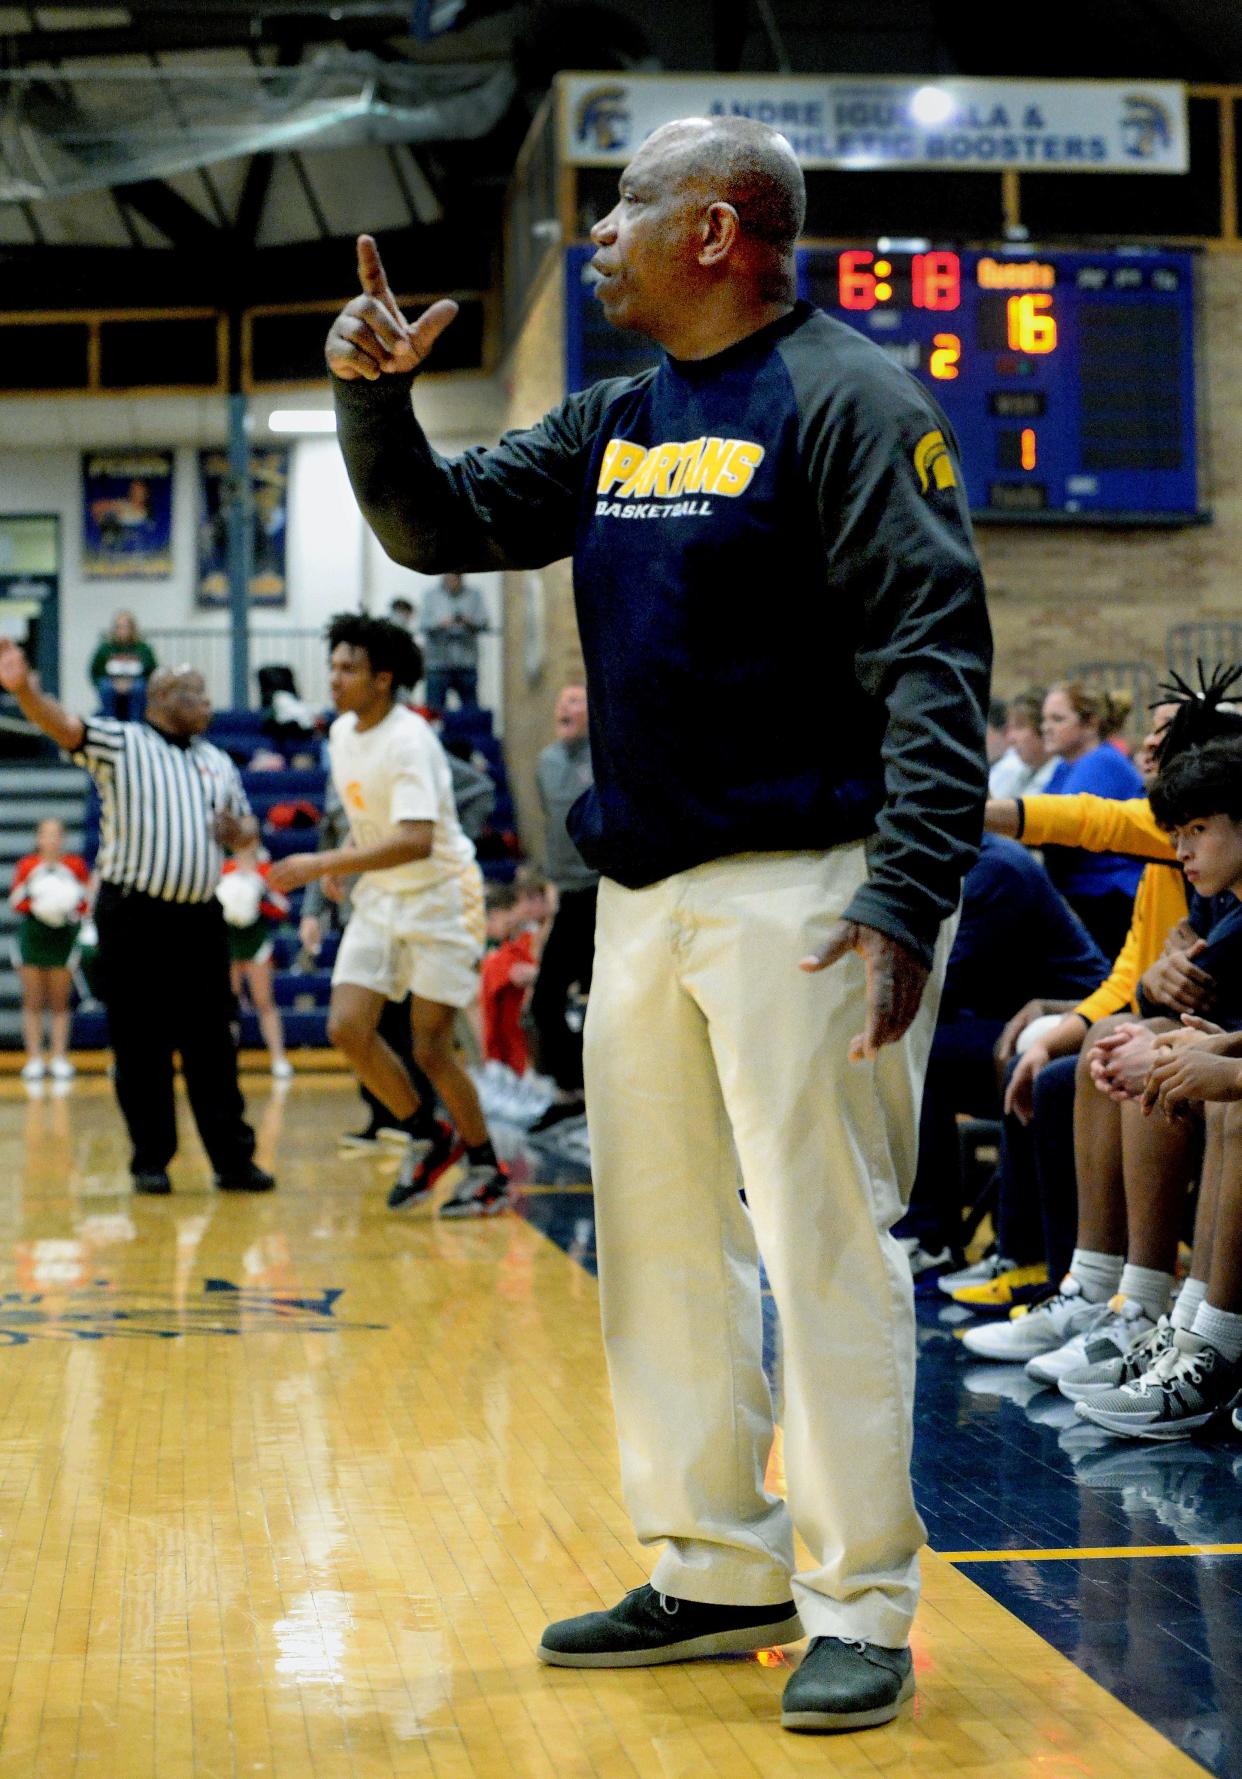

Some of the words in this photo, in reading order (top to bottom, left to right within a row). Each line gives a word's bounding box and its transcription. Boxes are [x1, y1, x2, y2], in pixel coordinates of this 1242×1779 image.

[926, 135, 1108, 162] BOOSTERS
[1007, 293, 1057, 354] 16
[930, 333, 961, 380] 2
[1021, 428, 1036, 471] 1
[595, 501, 714, 519] BASKETBALL
